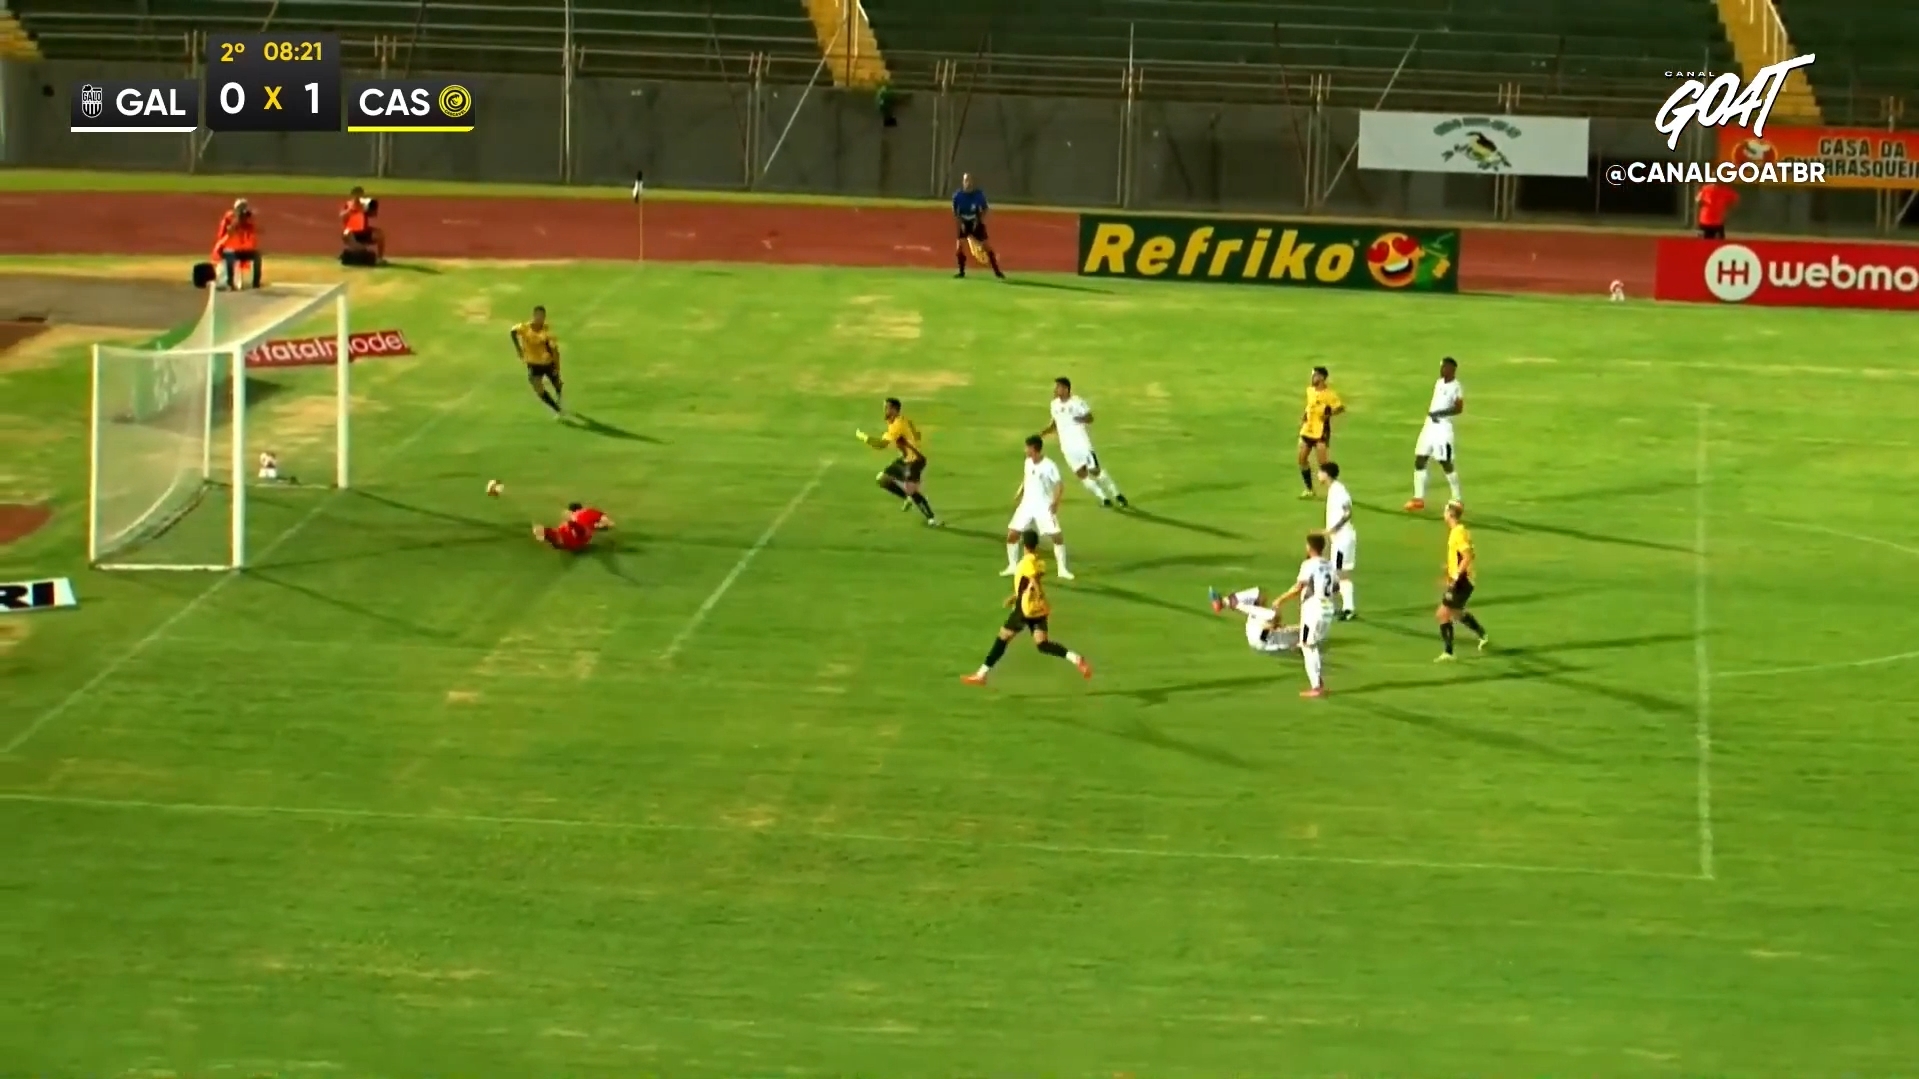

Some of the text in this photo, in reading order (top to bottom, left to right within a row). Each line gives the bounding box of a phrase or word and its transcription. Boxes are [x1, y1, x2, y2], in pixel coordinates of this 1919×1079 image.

[1820, 137, 1906, 158] CASA DA
[1783, 156, 1919, 179] RRASQUEI
[1084, 223, 1355, 282] Refriko
[1768, 254, 1919, 292] webmo
